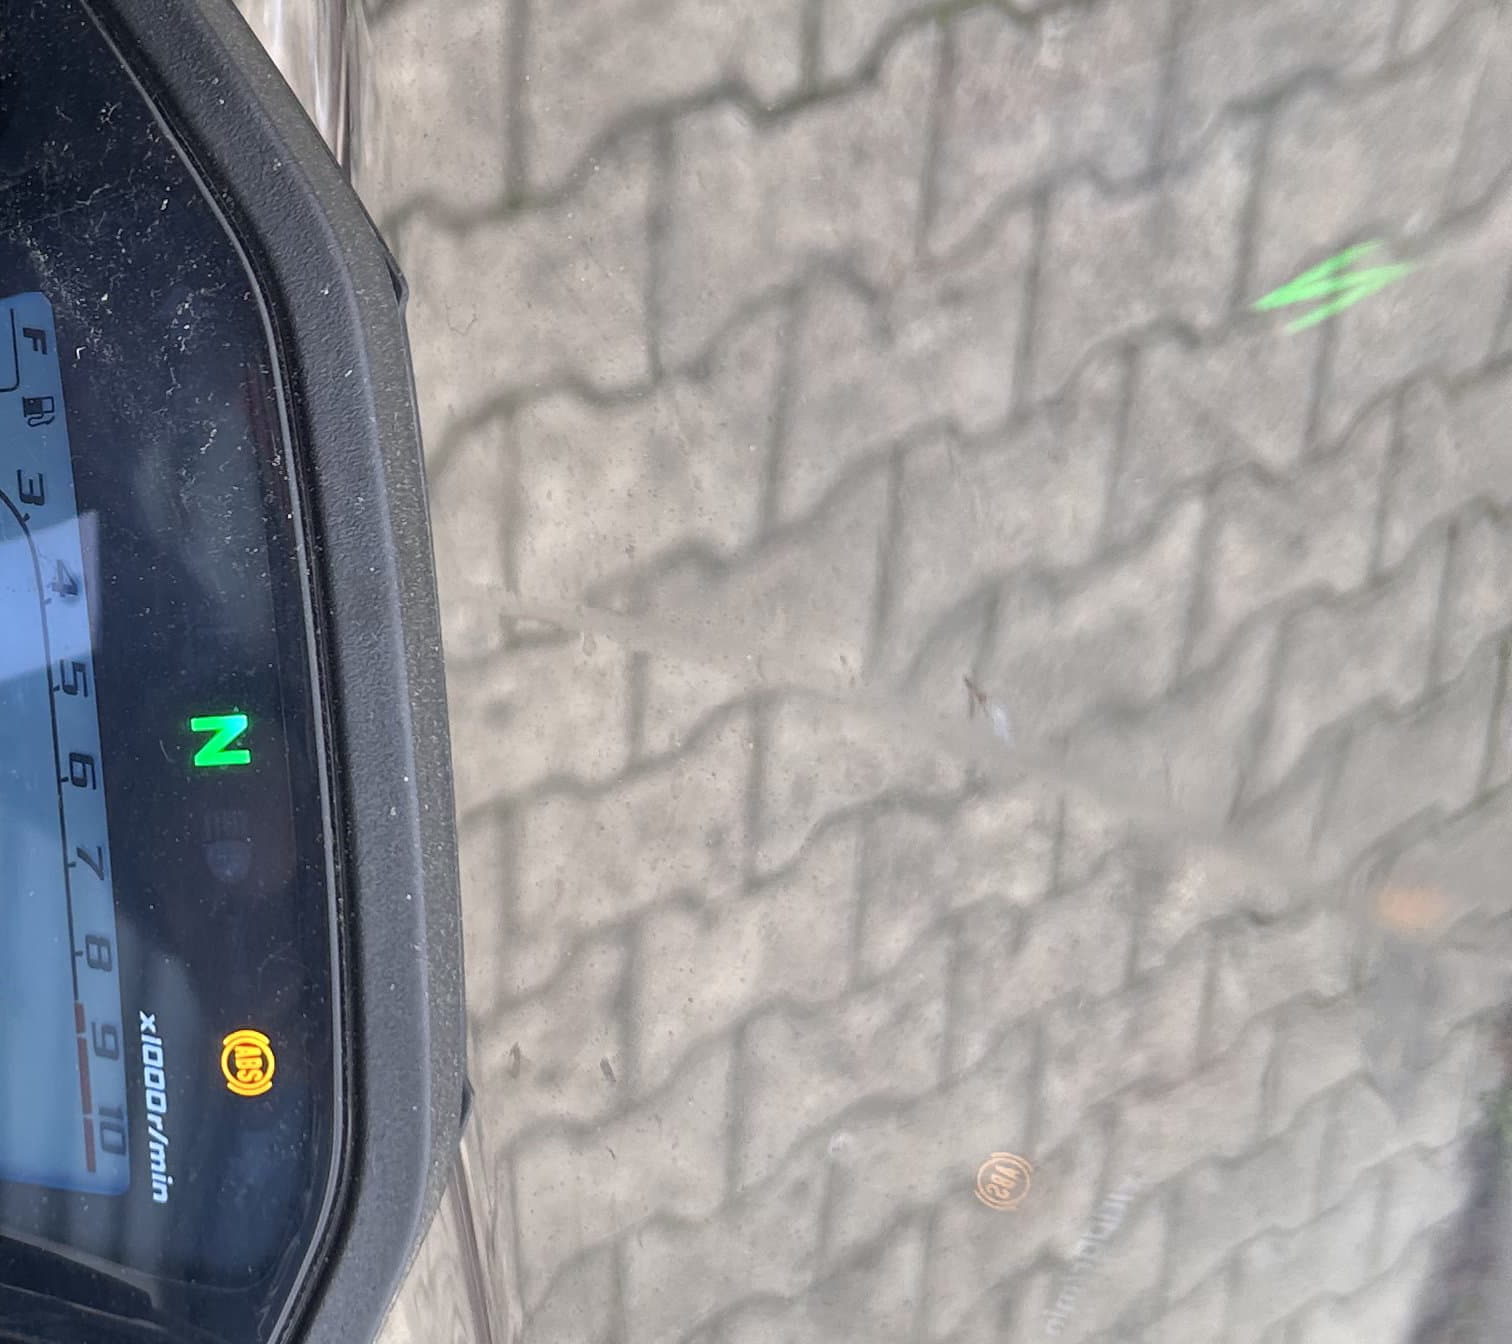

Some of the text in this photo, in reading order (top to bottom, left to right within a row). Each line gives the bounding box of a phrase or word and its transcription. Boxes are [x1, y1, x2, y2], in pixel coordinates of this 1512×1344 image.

[23, 327, 48, 355] F
[17, 469, 45, 506] 3
[51, 559, 78, 597] 4
[60, 659, 88, 698] 5
[191, 714, 251, 767] N
[69, 752, 96, 790] 6
[77, 846, 104, 881] 7
[85, 933, 113, 972] 8
[91, 1022, 120, 1061] 9
[234, 1044, 264, 1084] ABS
[139, 1010, 173, 1203] x1000r/min
[98, 1104, 126, 1156] 10
